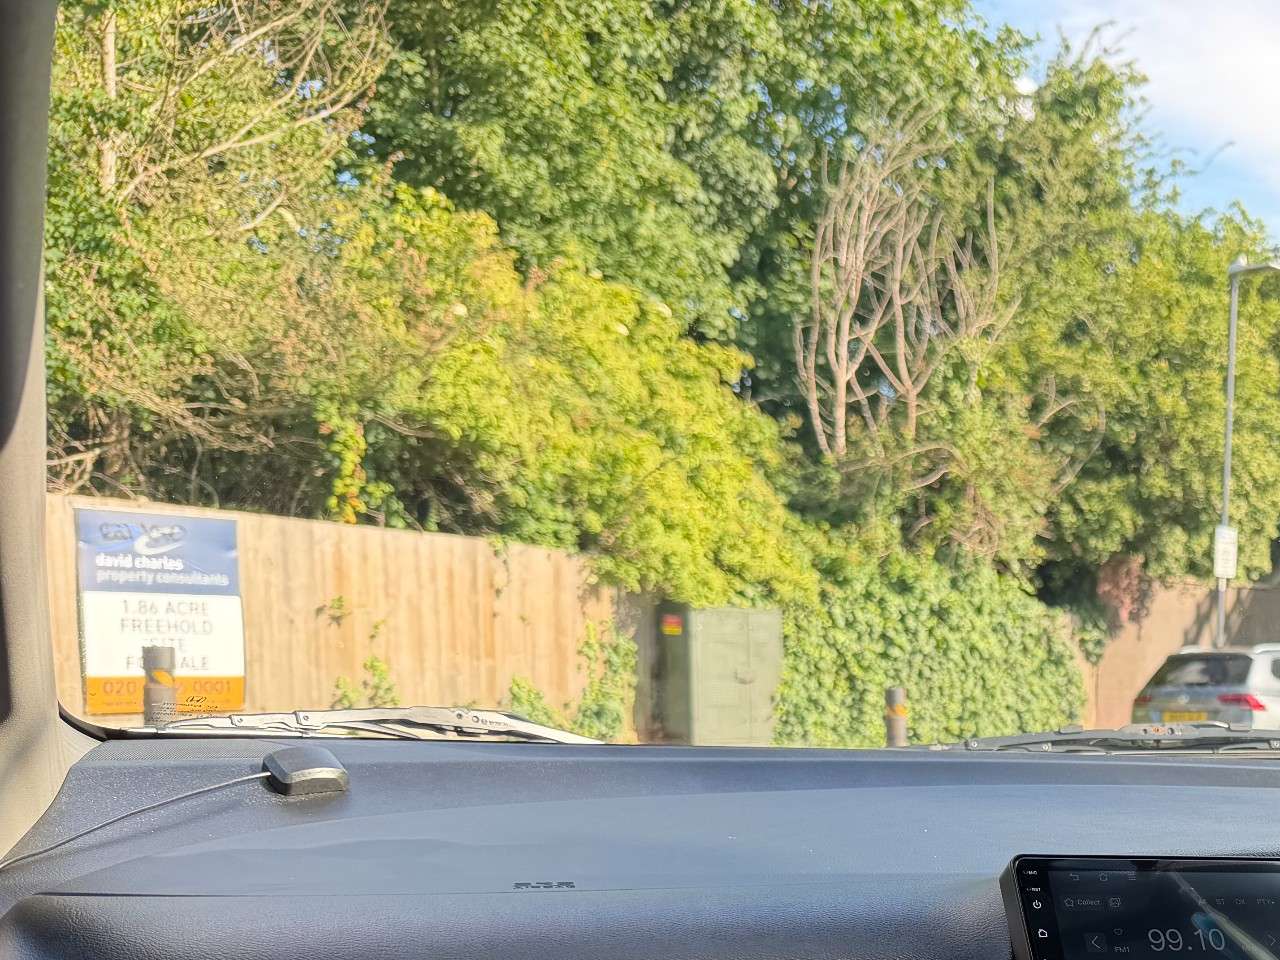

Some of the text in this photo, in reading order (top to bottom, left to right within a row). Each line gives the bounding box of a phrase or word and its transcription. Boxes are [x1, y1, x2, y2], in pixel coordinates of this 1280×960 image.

[96, 553, 184, 571] david charles
[120, 599, 209, 616] 1.86 ACRE
[120, 617, 214, 635] FREEHOLD
[1147, 928, 1227, 954] 99.10
